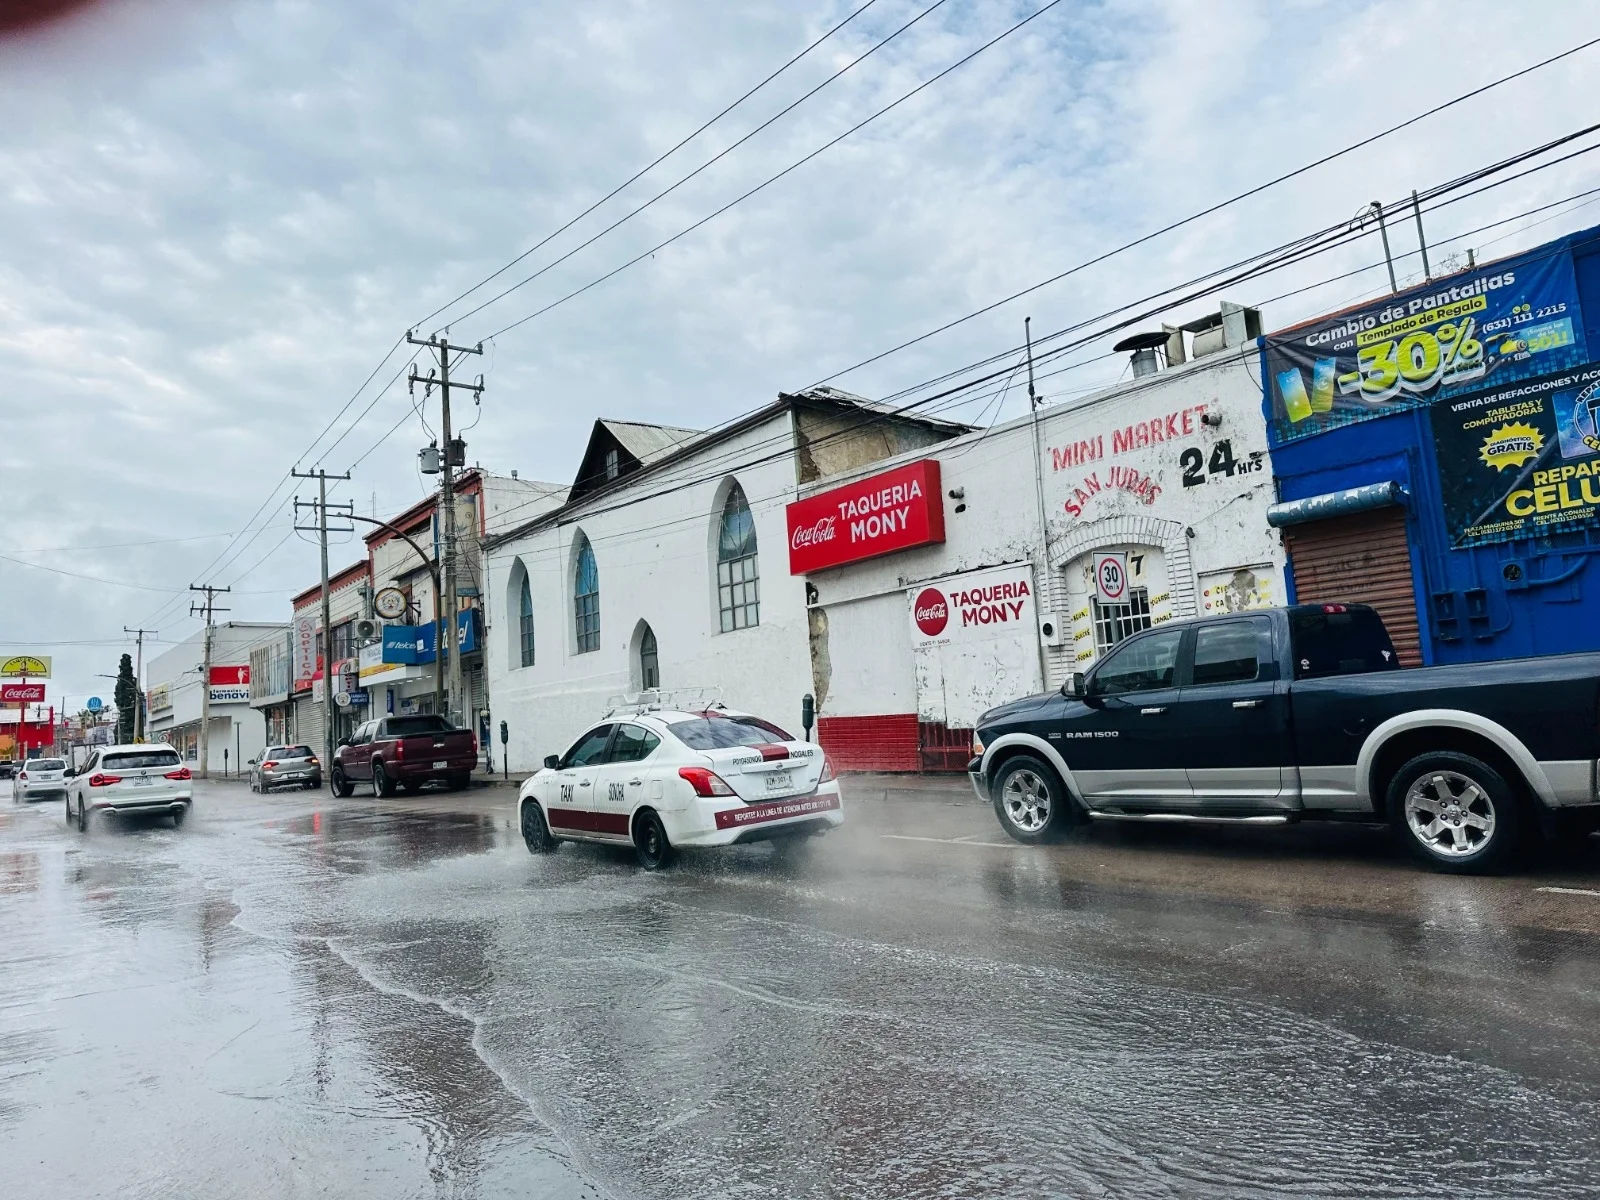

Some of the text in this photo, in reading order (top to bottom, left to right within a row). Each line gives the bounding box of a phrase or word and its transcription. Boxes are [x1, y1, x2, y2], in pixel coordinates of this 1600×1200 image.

[1305, 271, 1516, 347] Cambio de Pantallas
[1333, 299, 1483, 352] con Templado de Regalo
[1482, 302, 1567, 335] (631) 111 2215
[1338, 316, 1485, 400] -30%
[1451, 399, 1484, 413] VENTA
[1484, 394, 1498, 405] DE
[1498, 376, 1572, 401] REFACCIONES
[1571, 374, 1580, 384] Y
[1486, 397, 1543, 418] TABLETAS Y
[1462, 405, 1544, 430] COMPUTADORAS
[1052, 403, 1208, 472] MINI MARKET
[1487, 441, 1535, 456] GRATIS
[1179, 438, 1240, 487] 24
[838, 479, 922, 521] TAQUERIA
[1064, 466, 1163, 517] SAN JUDAS
[1505, 477, 1600, 517] CELU
[791, 515, 837, 550] Coca-Cola
[850, 505, 909, 543] MONY
[1103, 566, 1119, 583] 30
[949, 580, 1030, 608] TAQUERIA
[916, 602, 946, 622] Coca-Cola
[962, 600, 1025, 628] MONY
[1066, 731, 1093, 739] RAM
[1093, 730, 1119, 738] 1500
[790, 750, 814, 759] NOGALES
[560, 784, 575, 803] TAXI
